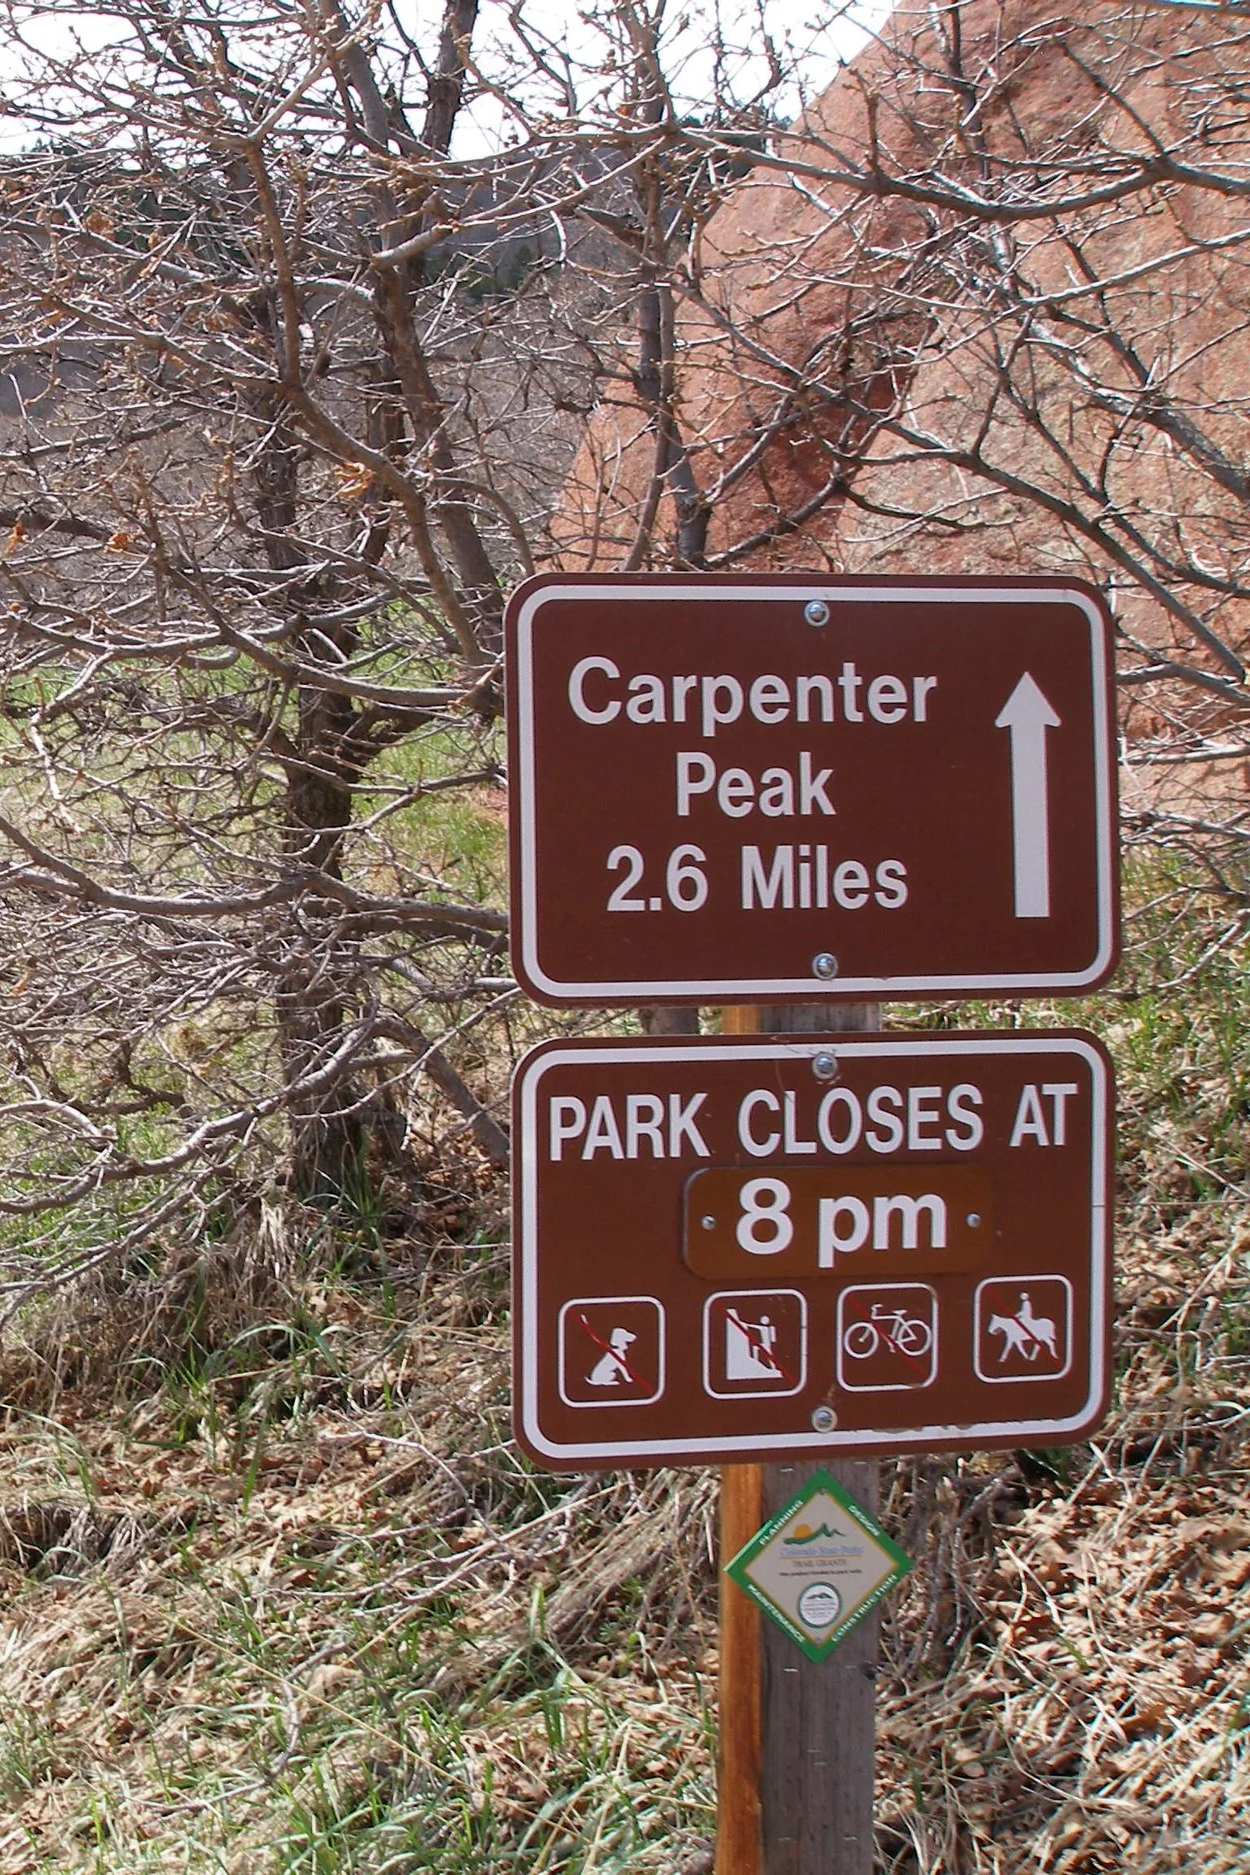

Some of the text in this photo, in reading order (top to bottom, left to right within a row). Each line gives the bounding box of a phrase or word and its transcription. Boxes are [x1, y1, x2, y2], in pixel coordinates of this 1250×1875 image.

[567, 655, 938, 737] Carpenter
[676, 751, 836, 818] Peak
[606, 844, 909, 913] 2.6 Miles
[550, 1083, 1078, 1162] PARK CLOSES AT
[735, 1177, 948, 1268] 8 pm
[759, 1500, 804, 1546] PLANNING
[830, 1574, 899, 1643] CONSTRUCTION
